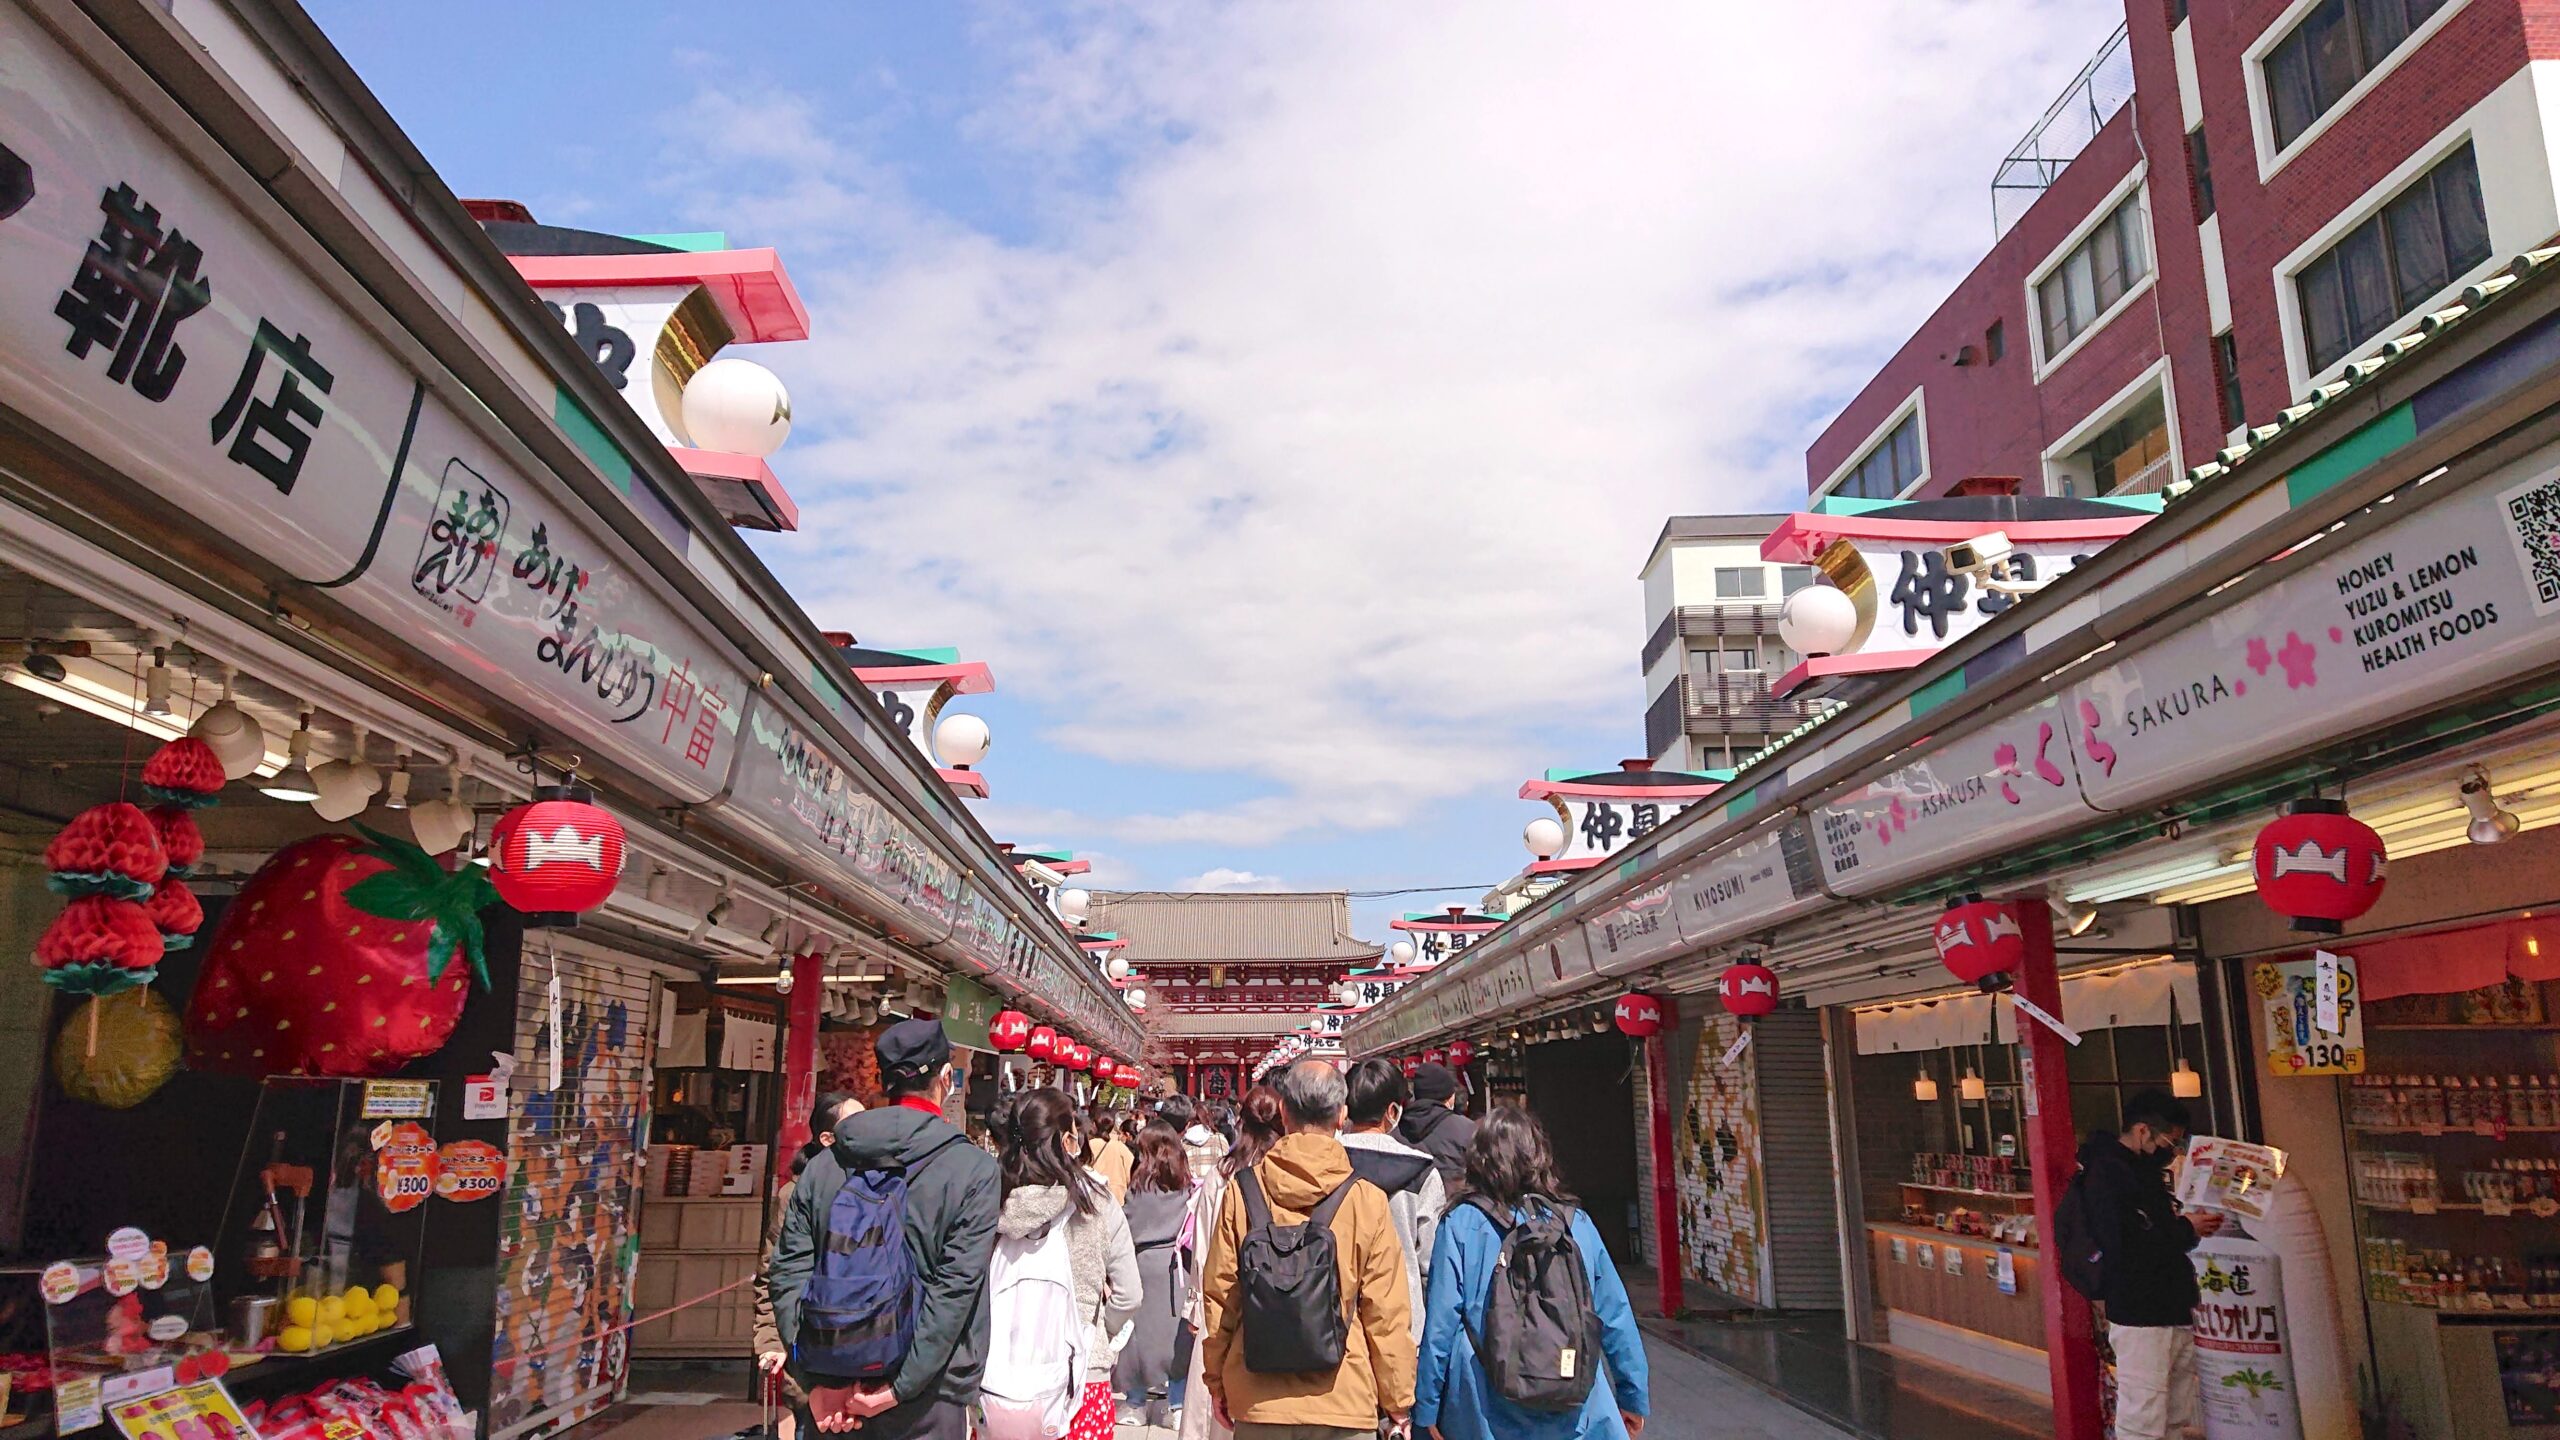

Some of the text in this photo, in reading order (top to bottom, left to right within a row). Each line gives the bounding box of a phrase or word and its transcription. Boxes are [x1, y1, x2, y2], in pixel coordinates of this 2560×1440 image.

[54, 181, 335, 496] 靴店
[2336, 552, 2396, 595] HONEY
[2345, 546, 2478, 620] YUZU & LEMON
[2353, 590, 2455, 648] KUROMITSU
[2362, 603, 2499, 673] HEALTH FOODS
[659, 657, 729, 769] 中富
[2126, 673, 2230, 738] SAKURA
[1921, 775, 1988, 818] ASAKUSA
[1693, 873, 1746, 912] KIYOSUMI
[397, 1176, 429, 1193] ¥300
[458, 1177, 497, 1189] ¥300
